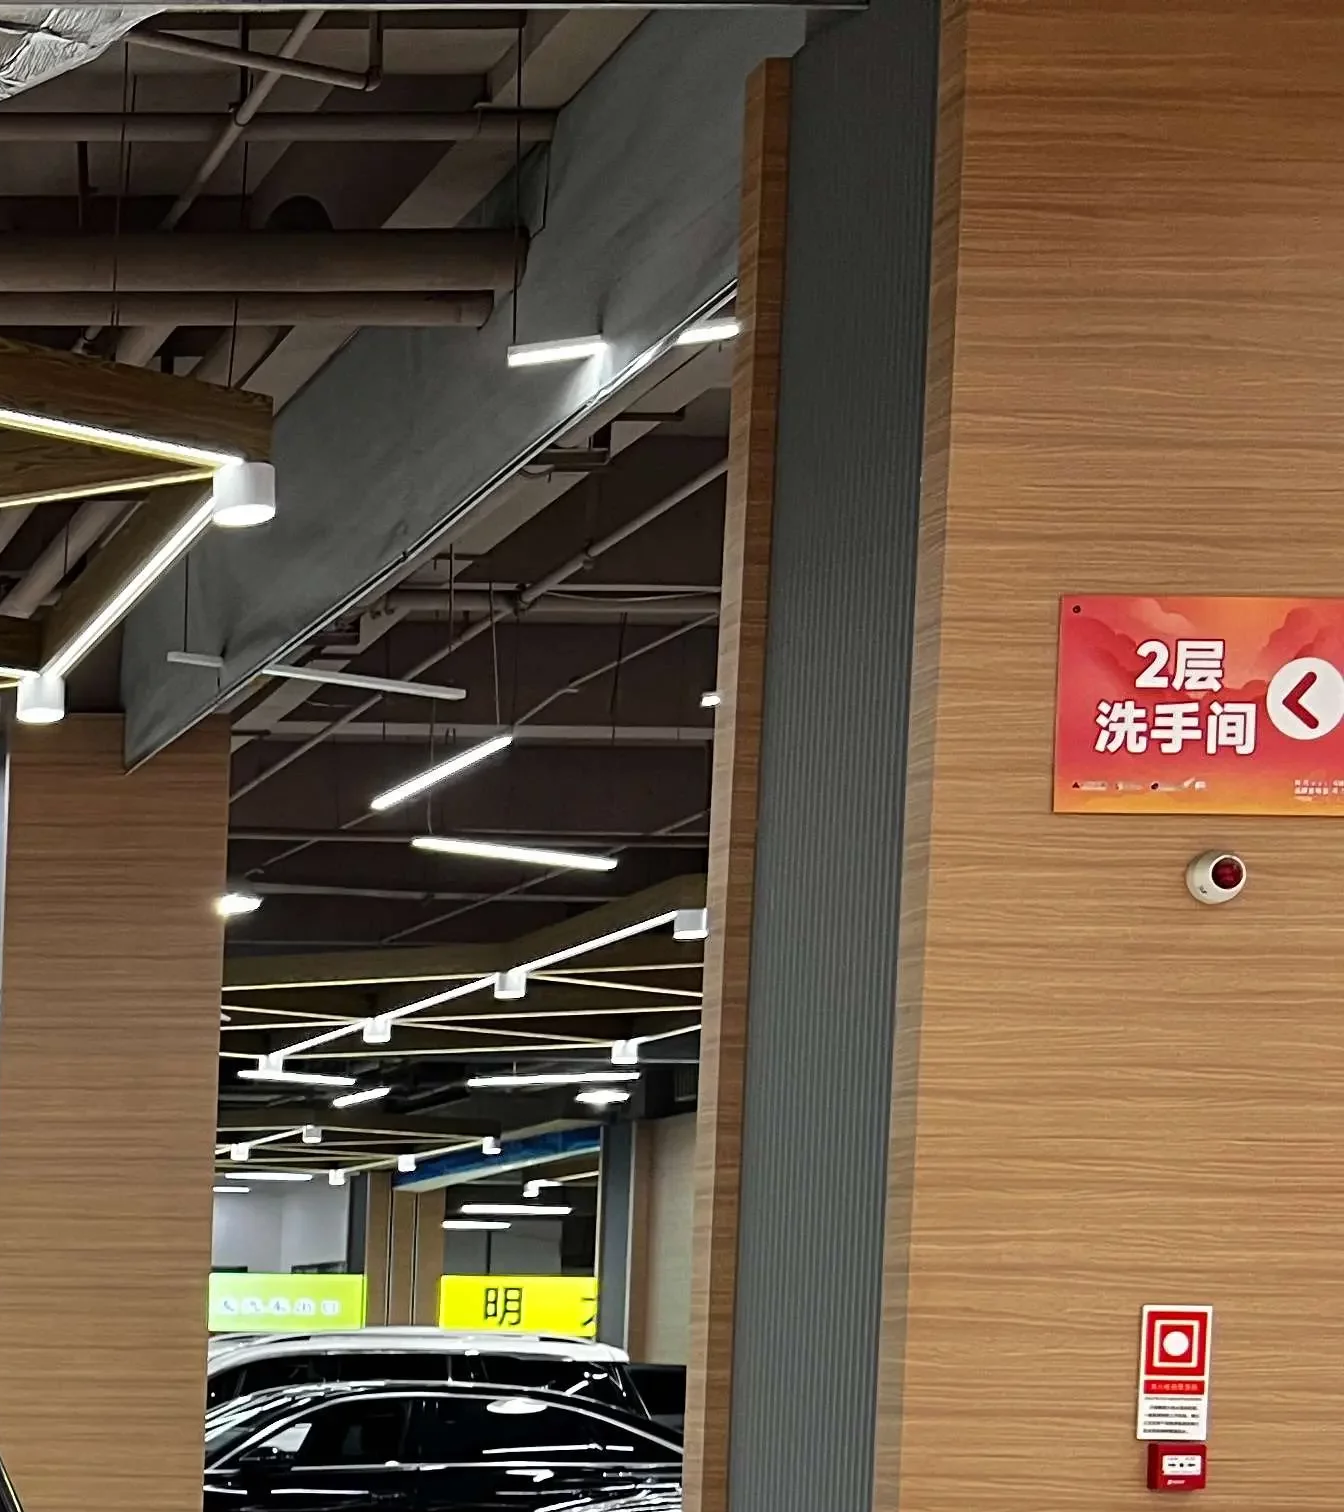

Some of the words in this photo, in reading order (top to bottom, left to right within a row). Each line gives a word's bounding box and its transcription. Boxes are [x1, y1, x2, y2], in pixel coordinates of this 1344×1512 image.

[1135, 638, 1225, 693] 2层
[1093, 700, 1257, 755] 洗手间
[484, 1286, 523, 1326] 明
